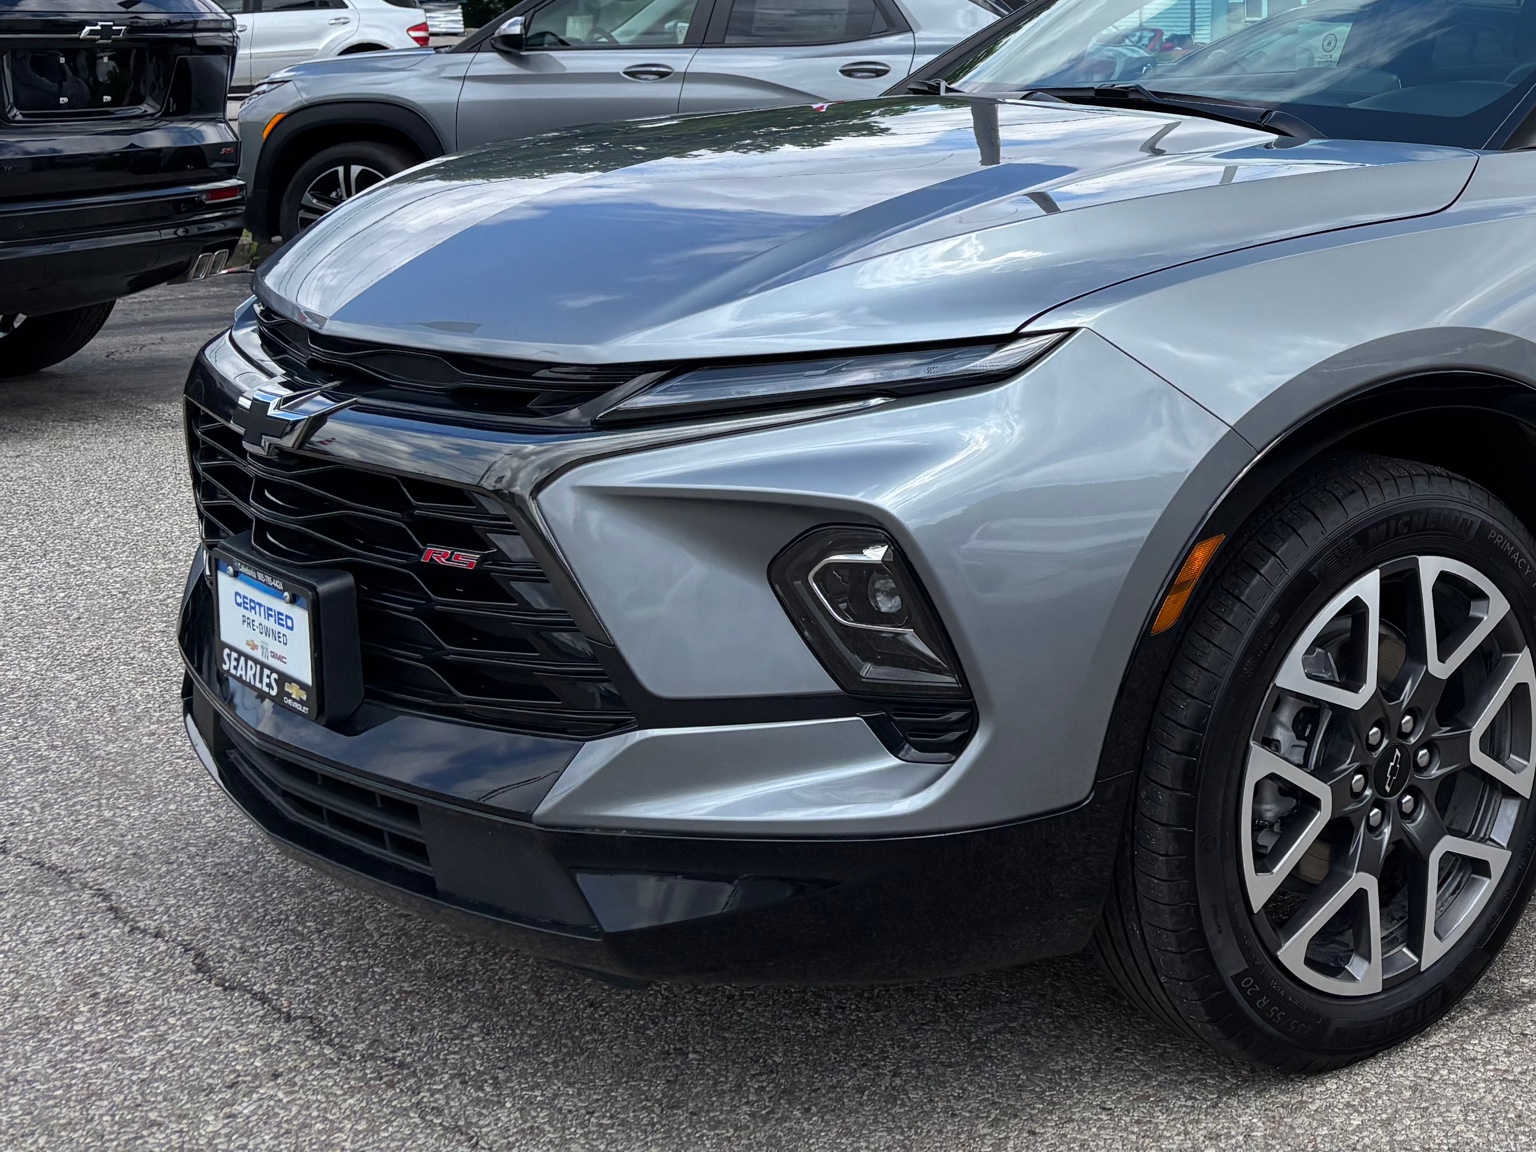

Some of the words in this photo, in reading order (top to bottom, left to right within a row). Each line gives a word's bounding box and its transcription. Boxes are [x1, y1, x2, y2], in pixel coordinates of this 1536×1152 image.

[1367, 508, 1476, 544] MICHELIN
[1487, 529, 1532, 576] PRIMACY
[420, 547, 480, 570] RS
[234, 591, 295, 632] CERTIFIED
[242, 614, 288, 646] PRE-OWNED
[270, 650, 287, 664] GMC
[222, 647, 279, 697] SEARLES
[283, 696, 309, 715] CHEVROLET
[1241, 976, 1260, 996] 20
